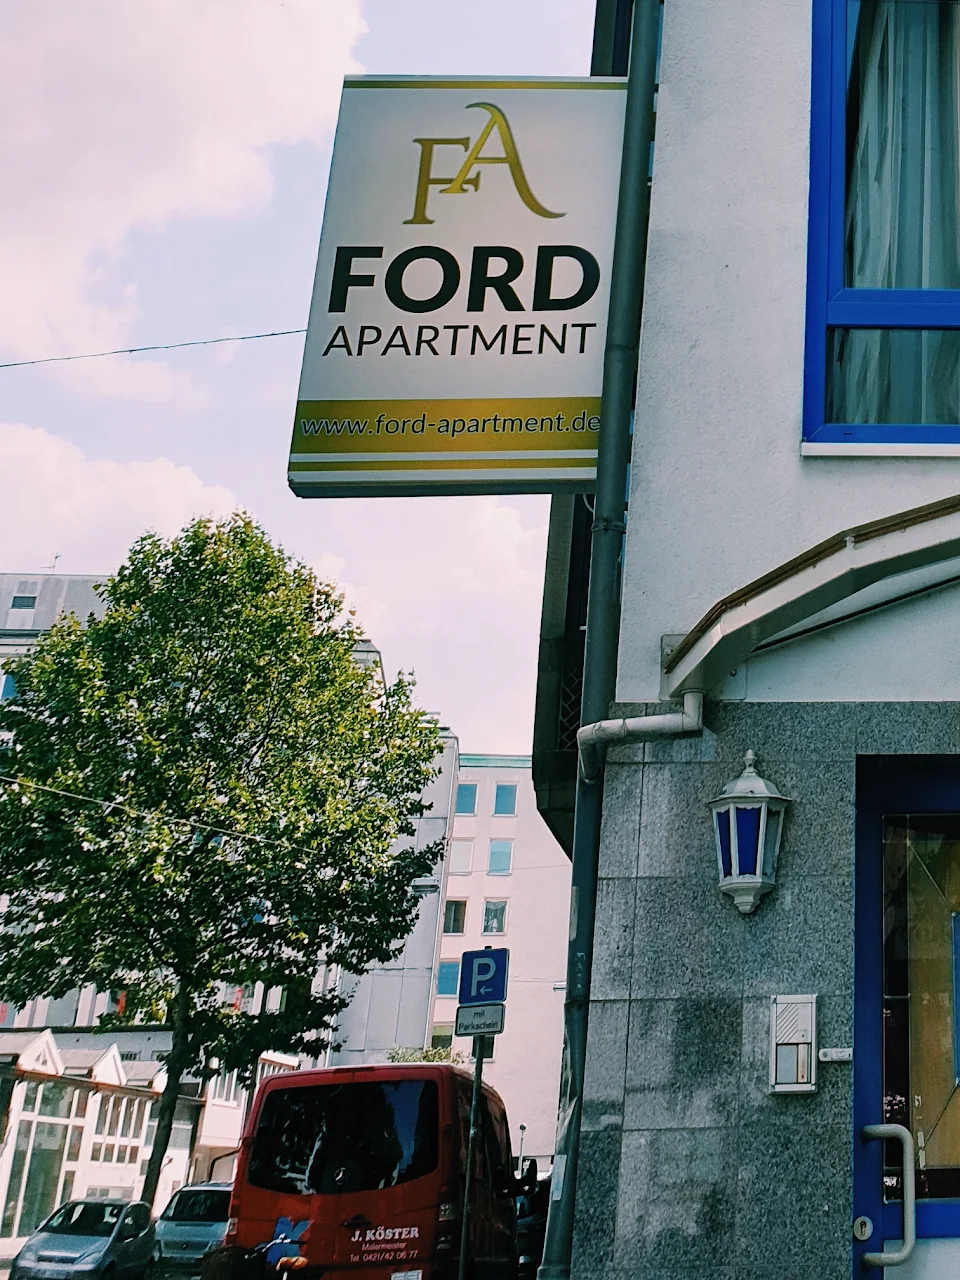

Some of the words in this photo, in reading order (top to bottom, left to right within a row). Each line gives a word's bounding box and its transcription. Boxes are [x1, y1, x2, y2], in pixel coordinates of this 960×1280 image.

[402, 101, 568, 225] FA
[327, 244, 601, 314] FORD
[322, 322, 597, 357] APARTMENT
[301, 409, 601, 439] www.ford-apartment.de
[470, 957, 497, 997] P
[459, 1021, 499, 1031] Parkschein
[473, 1010, 486, 1019] mit
[351, 1230, 363, 1242] J.
[365, 1226, 420, 1241] KÖSTER
